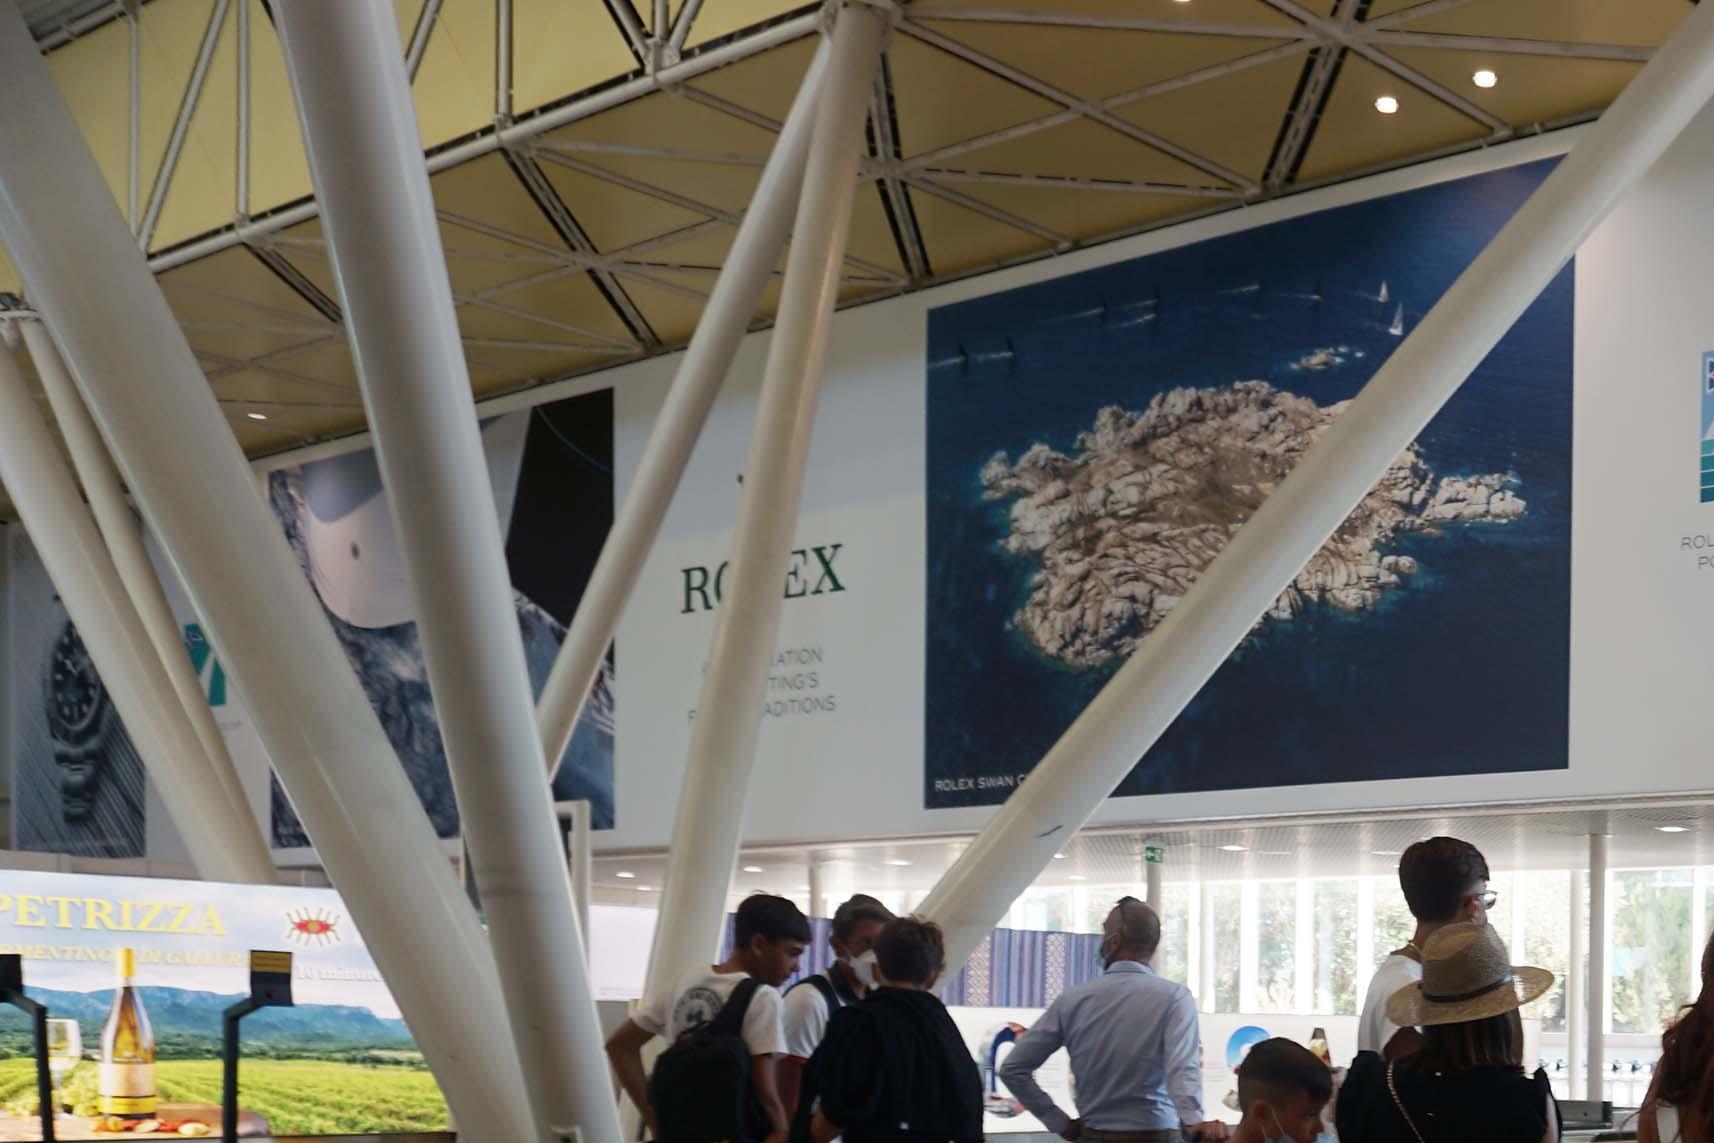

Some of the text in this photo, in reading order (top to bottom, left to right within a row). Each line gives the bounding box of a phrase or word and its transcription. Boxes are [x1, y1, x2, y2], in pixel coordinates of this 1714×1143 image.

[681, 544, 846, 614] REX
[934, 777, 975, 792] ROLEX
[977, 774, 1014, 790] SWAN
